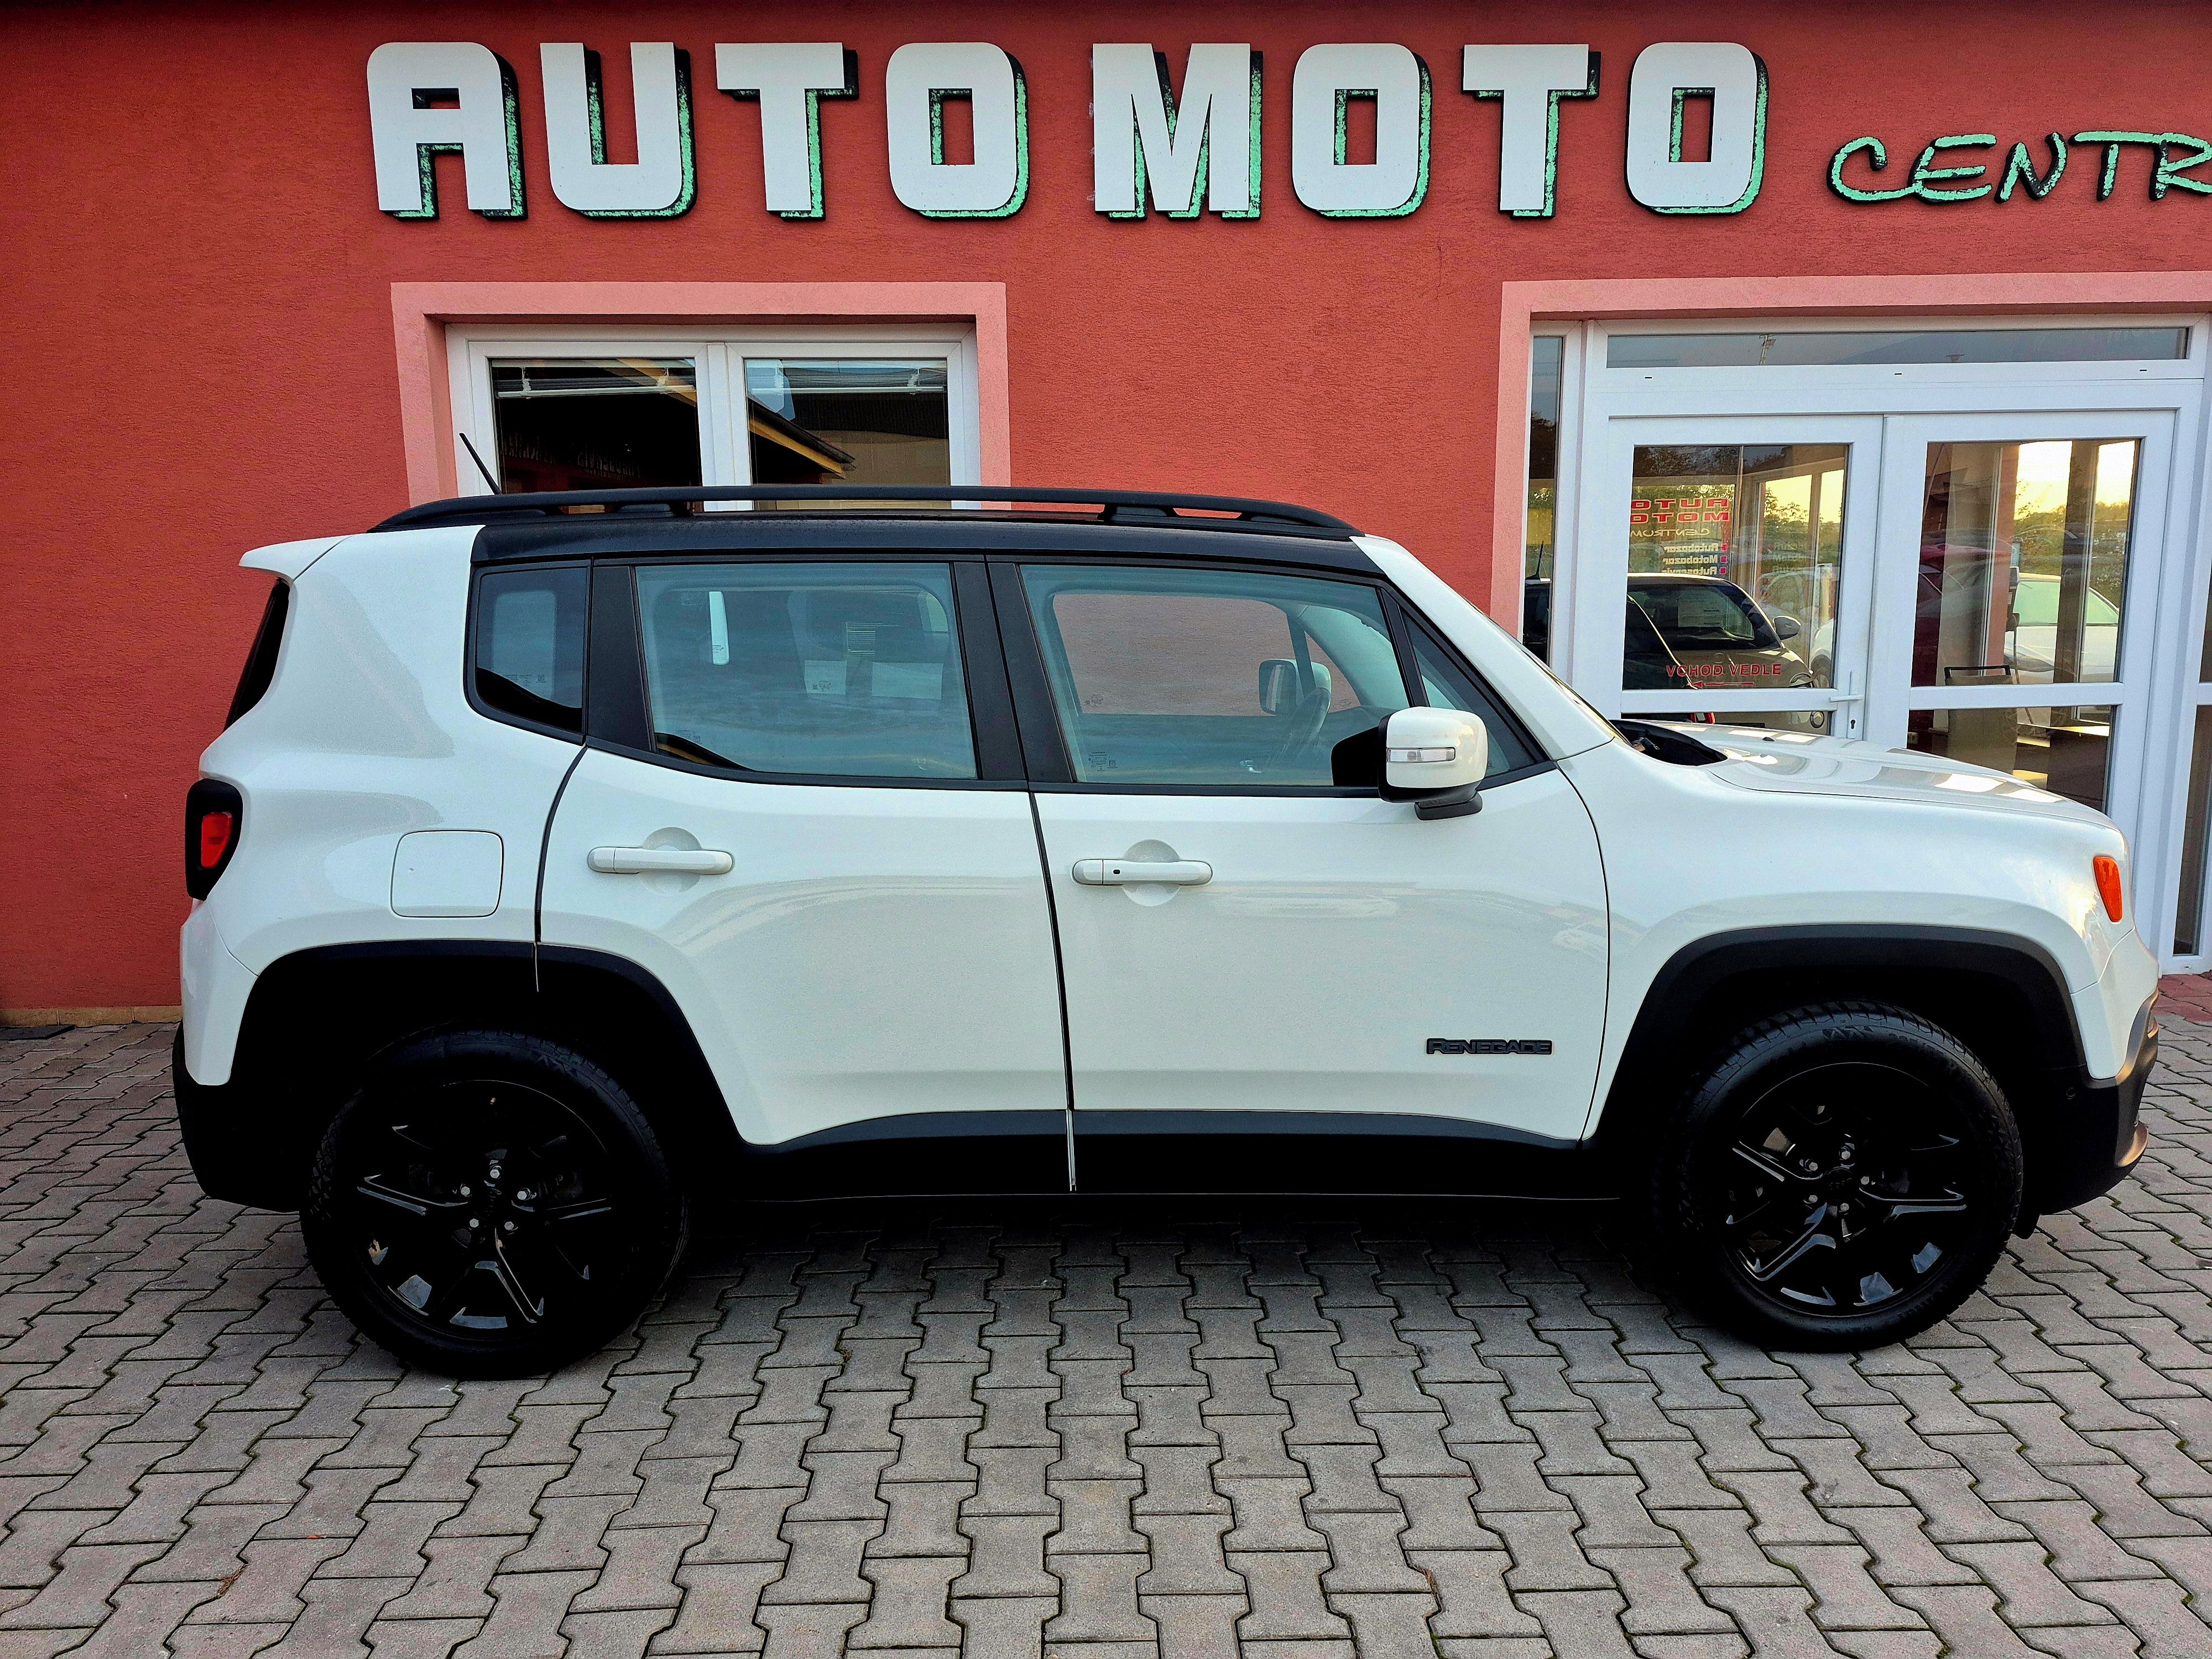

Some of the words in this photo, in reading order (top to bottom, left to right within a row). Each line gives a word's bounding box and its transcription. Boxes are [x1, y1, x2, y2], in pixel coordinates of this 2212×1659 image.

[367, 42, 1029, 220] AUTO
[1092, 42, 1766, 220] MOTO
[1827, 131, 2212, 204] CENTR
[1666, 664, 1724, 677] VCHOD
[1729, 663, 1782, 676] VEDLE
[1426, 1037, 1552, 1055] RENEGADE
